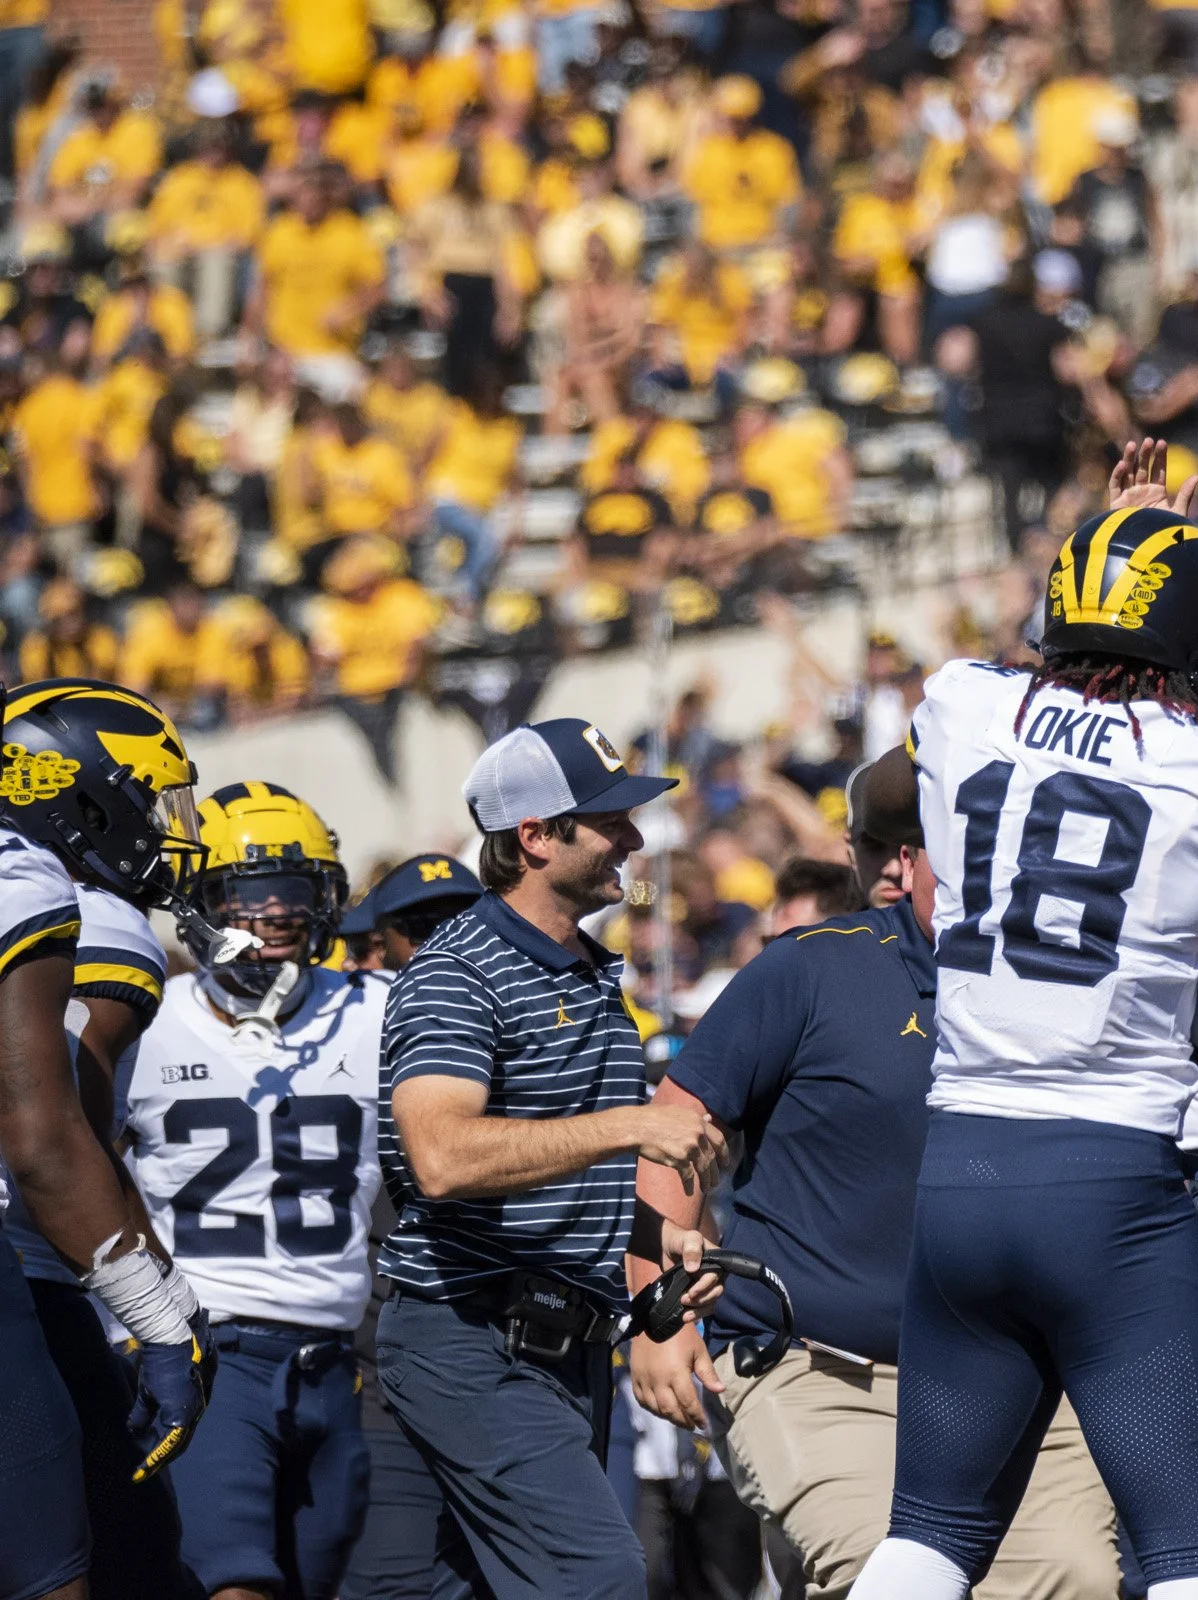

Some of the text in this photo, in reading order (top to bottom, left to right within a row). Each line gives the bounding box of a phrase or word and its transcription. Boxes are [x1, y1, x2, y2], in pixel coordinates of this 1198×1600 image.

[1024, 706, 1129, 767] OKIE
[417, 859, 453, 883] M
[934, 759, 1153, 988] 18
[163, 1094, 363, 1258] 28
[533, 1291, 567, 1310] meijer
